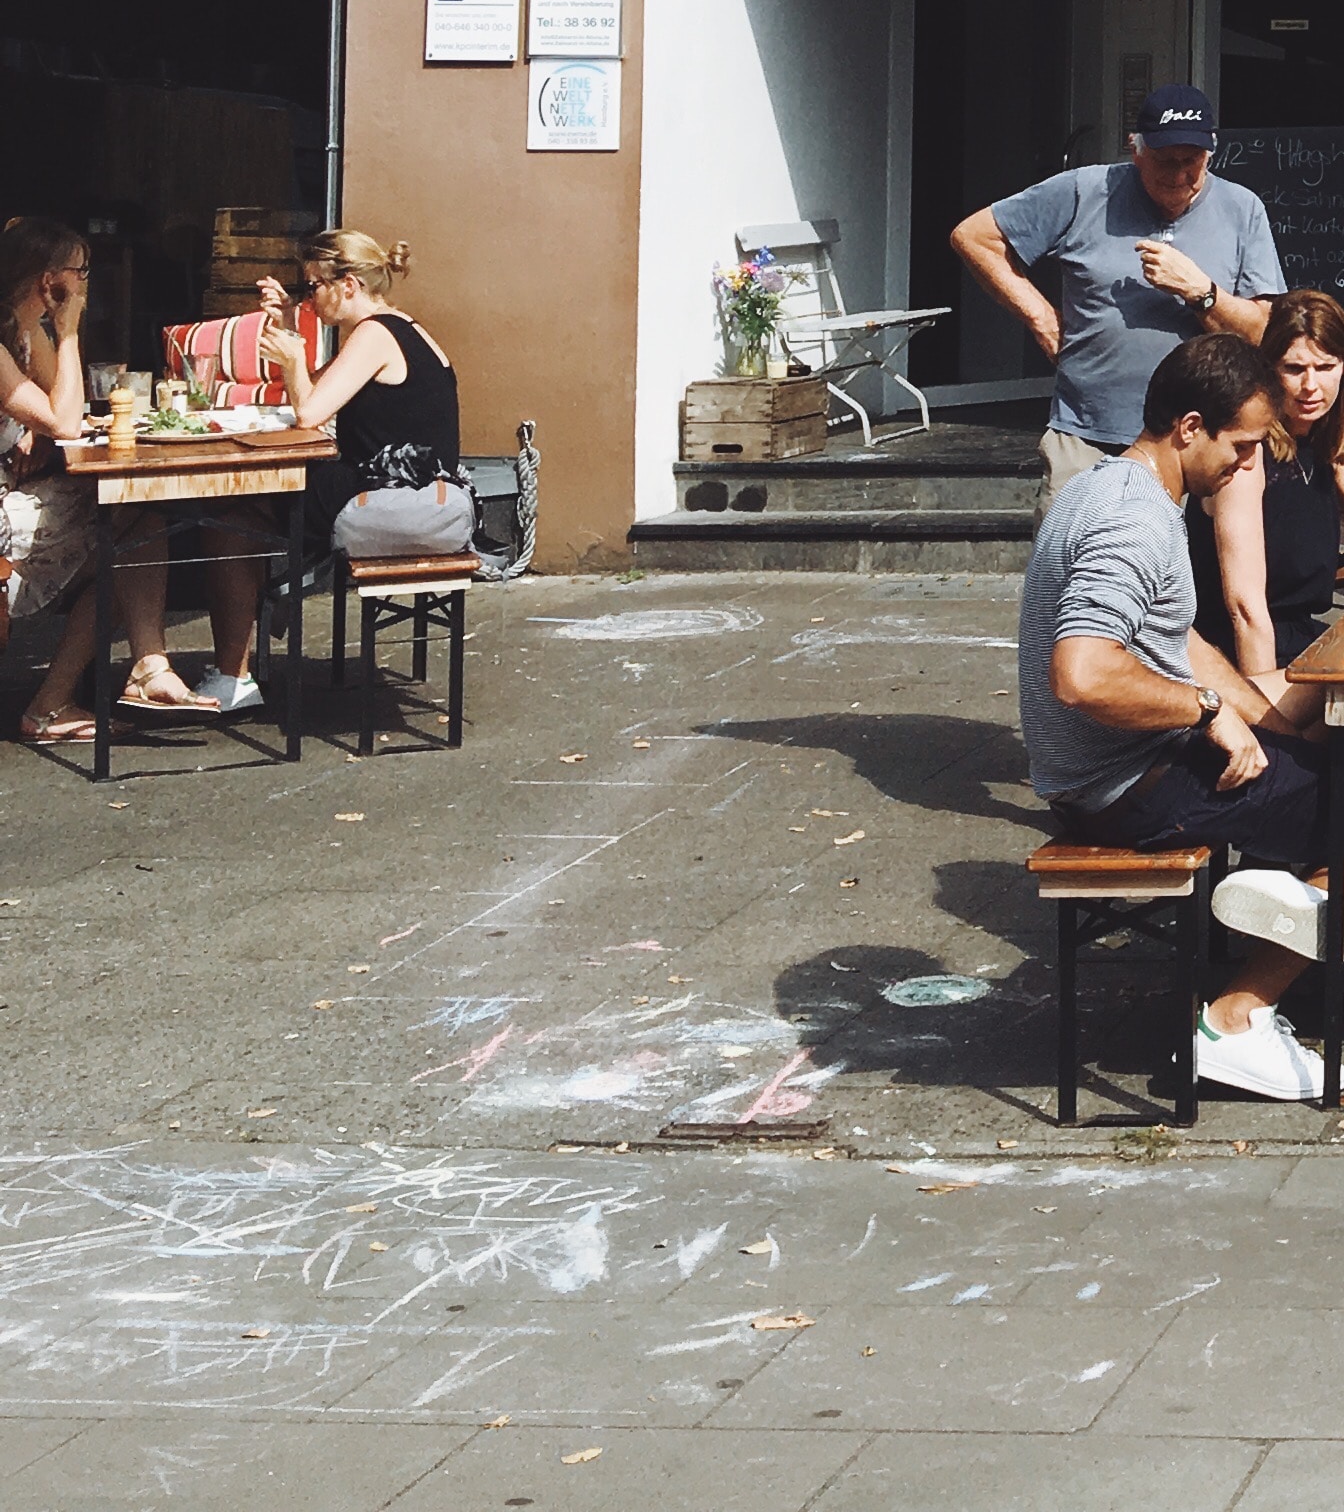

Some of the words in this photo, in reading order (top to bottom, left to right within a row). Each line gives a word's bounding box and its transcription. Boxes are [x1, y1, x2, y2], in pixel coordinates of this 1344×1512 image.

[564, 17, 579, 27] 38
[582, 17, 597, 27] 36
[601, 17, 615, 27] 92
[560, 77, 591, 88] EINE
[553, 90, 592, 102] WELT
[550, 103, 585, 114] NETZ
[553, 115, 596, 127] WERK
